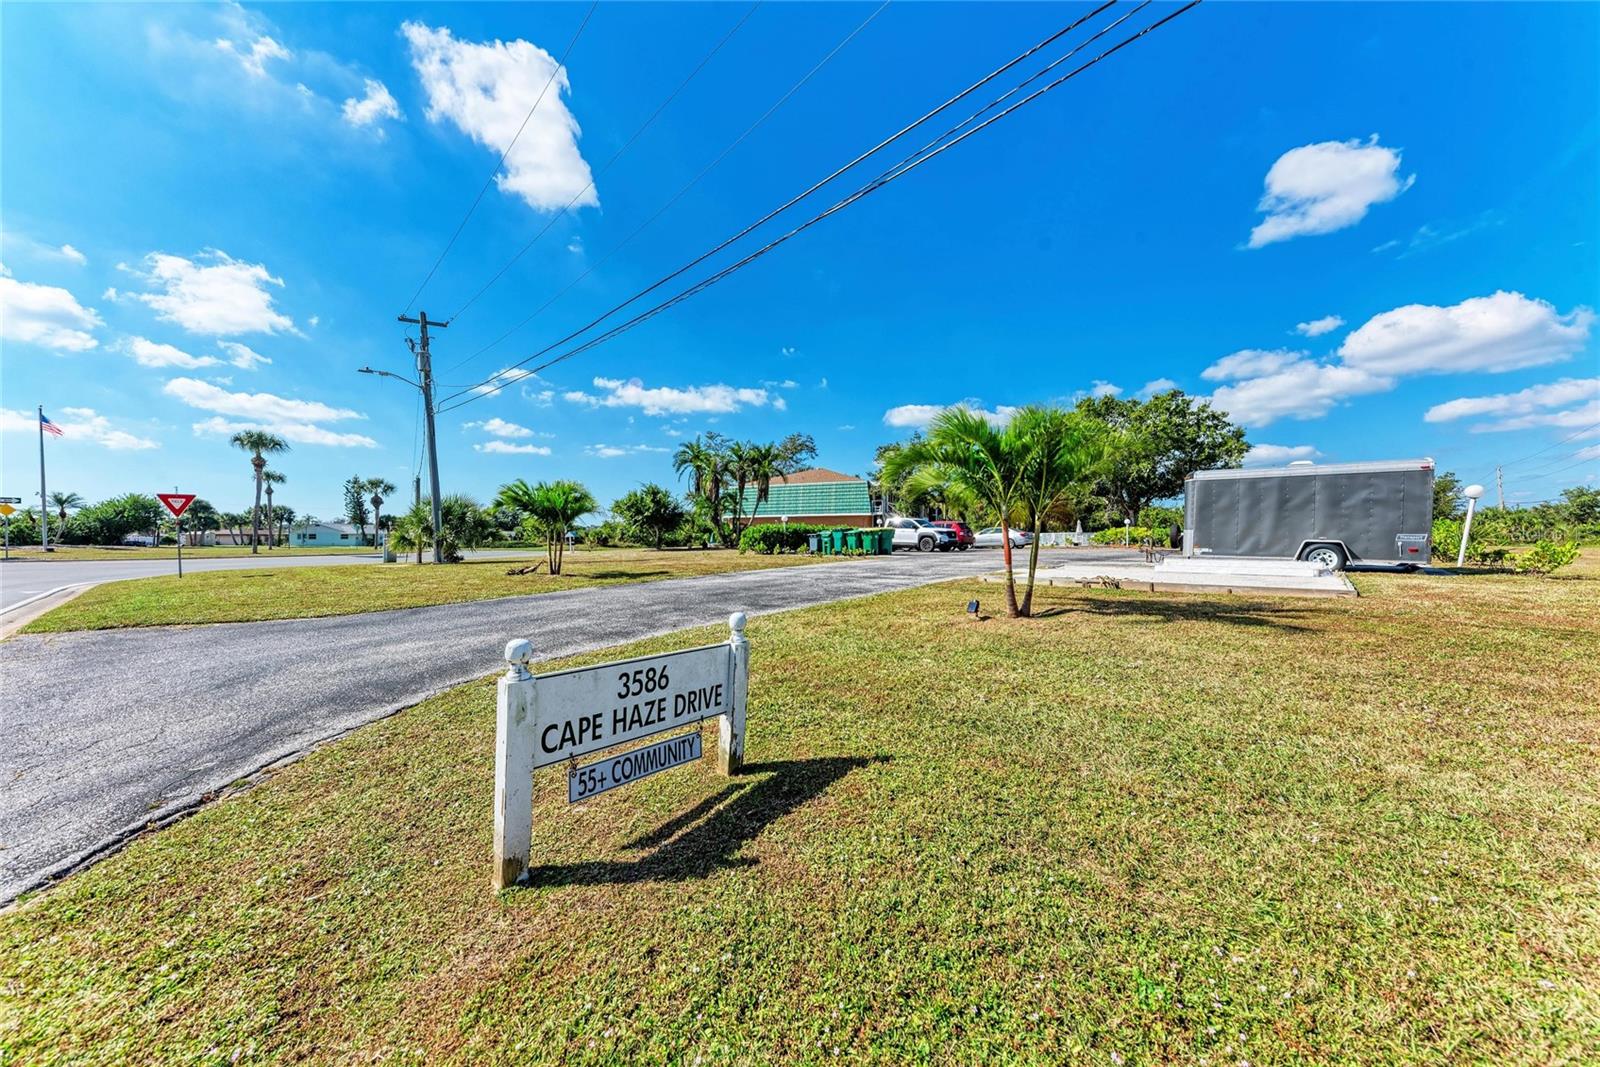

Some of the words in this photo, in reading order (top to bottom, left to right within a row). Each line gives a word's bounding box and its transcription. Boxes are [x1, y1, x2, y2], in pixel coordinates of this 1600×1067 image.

[617, 665, 670, 699] 3586
[541, 712, 603, 754] CAPE
[612, 698, 666, 735] HAZE
[674, 684, 723, 718] DRIVE
[578, 769, 607, 796] 55+
[611, 738, 695, 783] COMMUNITY
